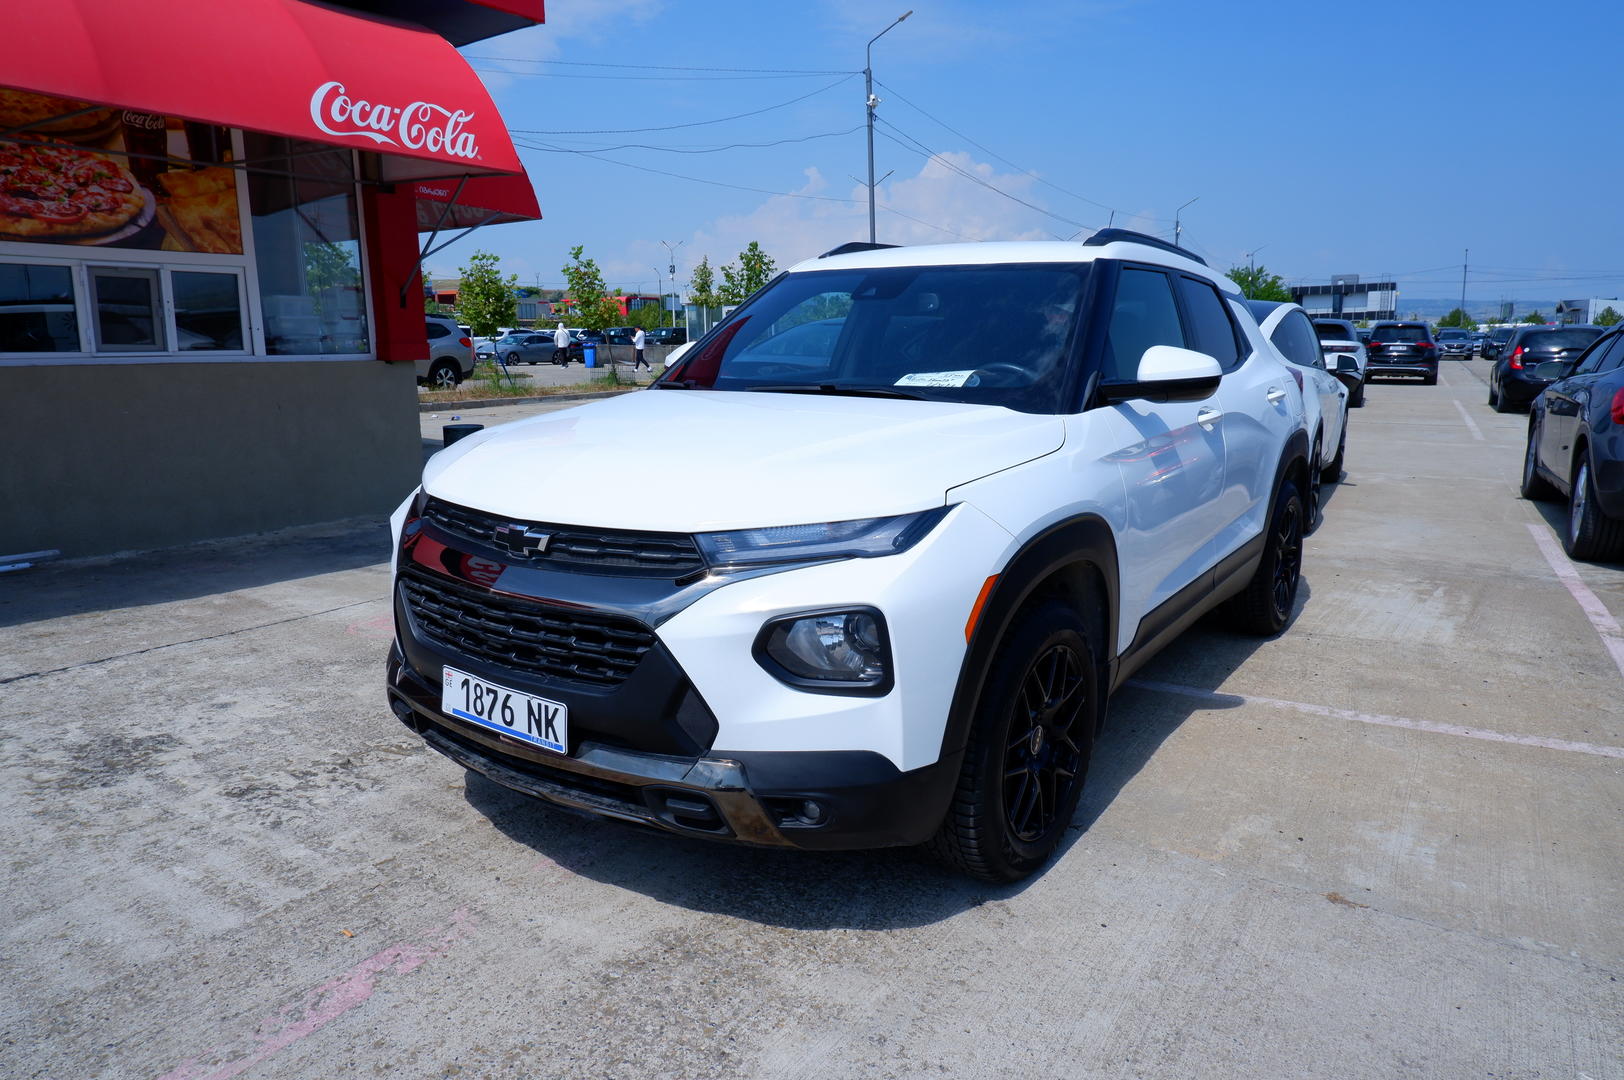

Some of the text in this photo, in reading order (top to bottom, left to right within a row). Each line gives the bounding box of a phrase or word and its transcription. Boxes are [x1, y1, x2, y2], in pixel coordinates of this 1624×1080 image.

[310, 81, 479, 159] Coca-Cola
[445, 678, 453, 688] GE
[461, 678, 560, 743] 1876 NK
